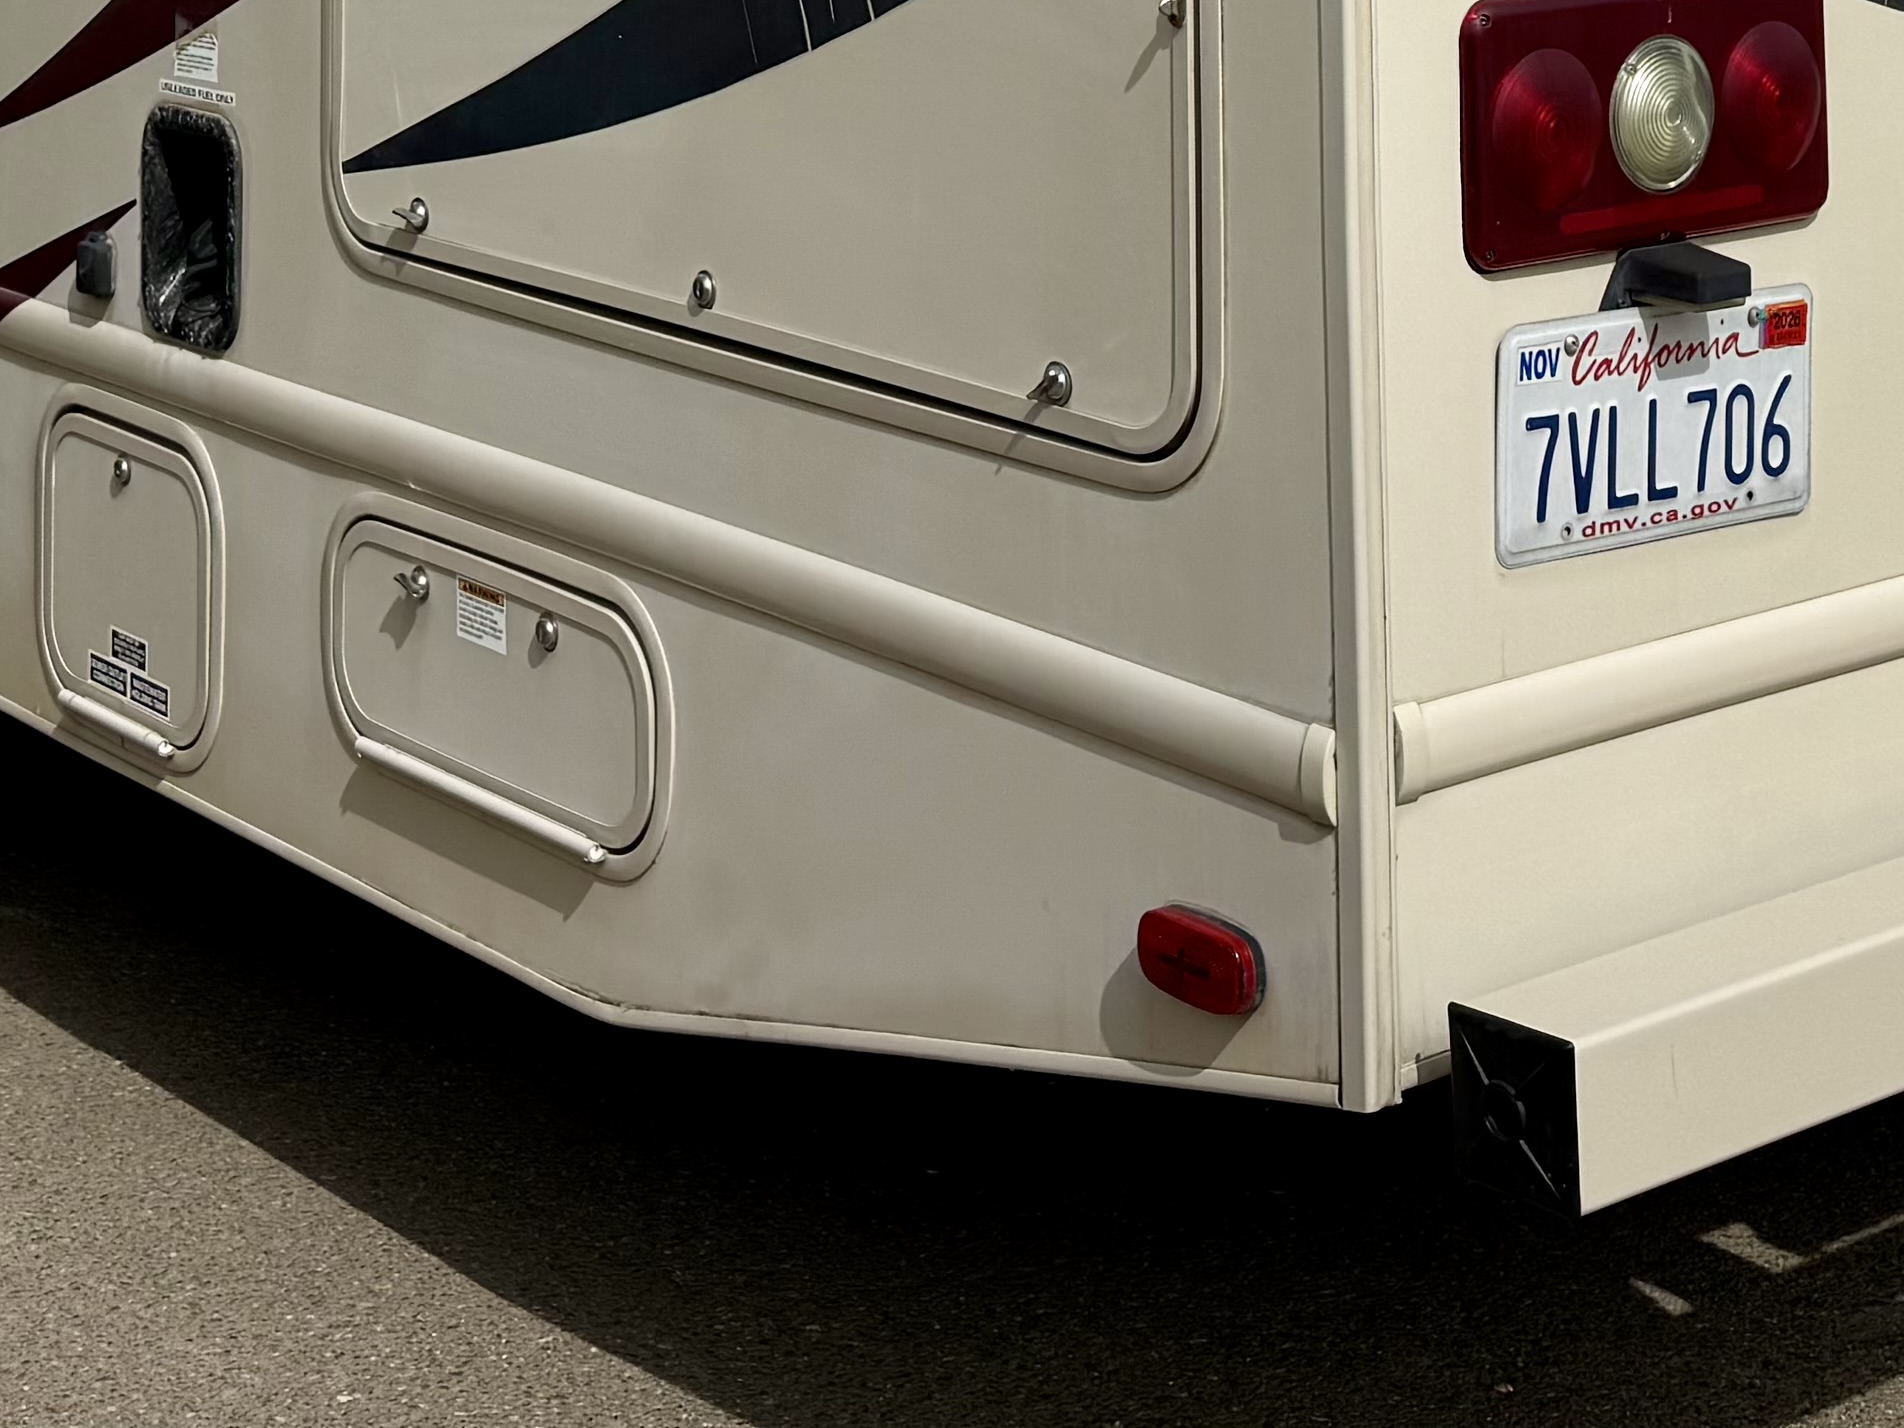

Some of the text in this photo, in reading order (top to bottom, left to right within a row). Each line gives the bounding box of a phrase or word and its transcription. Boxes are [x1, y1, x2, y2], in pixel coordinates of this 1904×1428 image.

[1519, 322, 1760, 392] NOV California
[1525, 374, 1793, 524] 7VLL706
[1581, 496, 1739, 539] dmv.ca.gov
